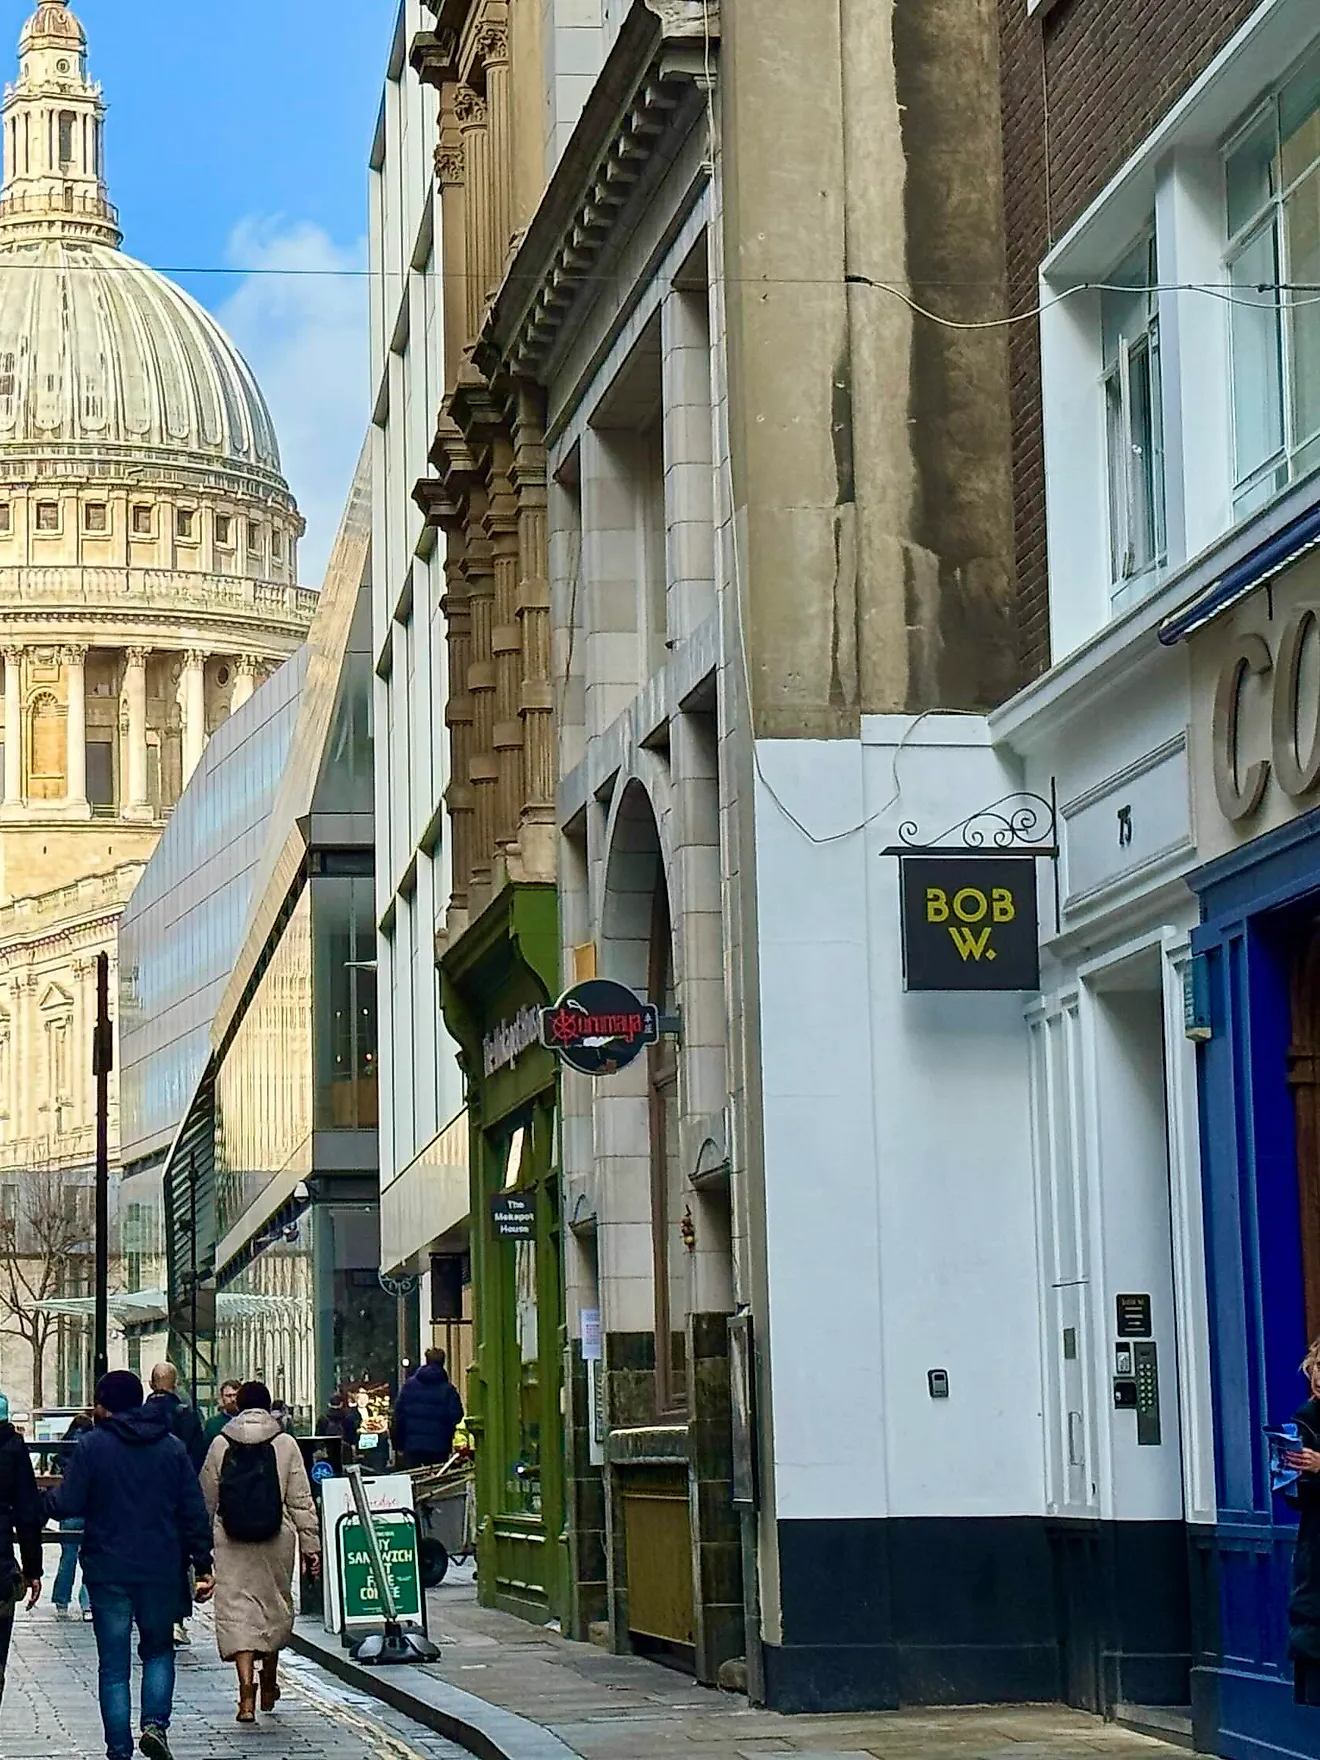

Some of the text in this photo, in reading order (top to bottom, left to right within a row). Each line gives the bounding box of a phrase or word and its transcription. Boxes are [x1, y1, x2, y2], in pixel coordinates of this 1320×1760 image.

[926, 887, 1016, 922] BOB
[947, 926, 998, 961] W.
[347, 1549, 413, 1565] SANWICH
